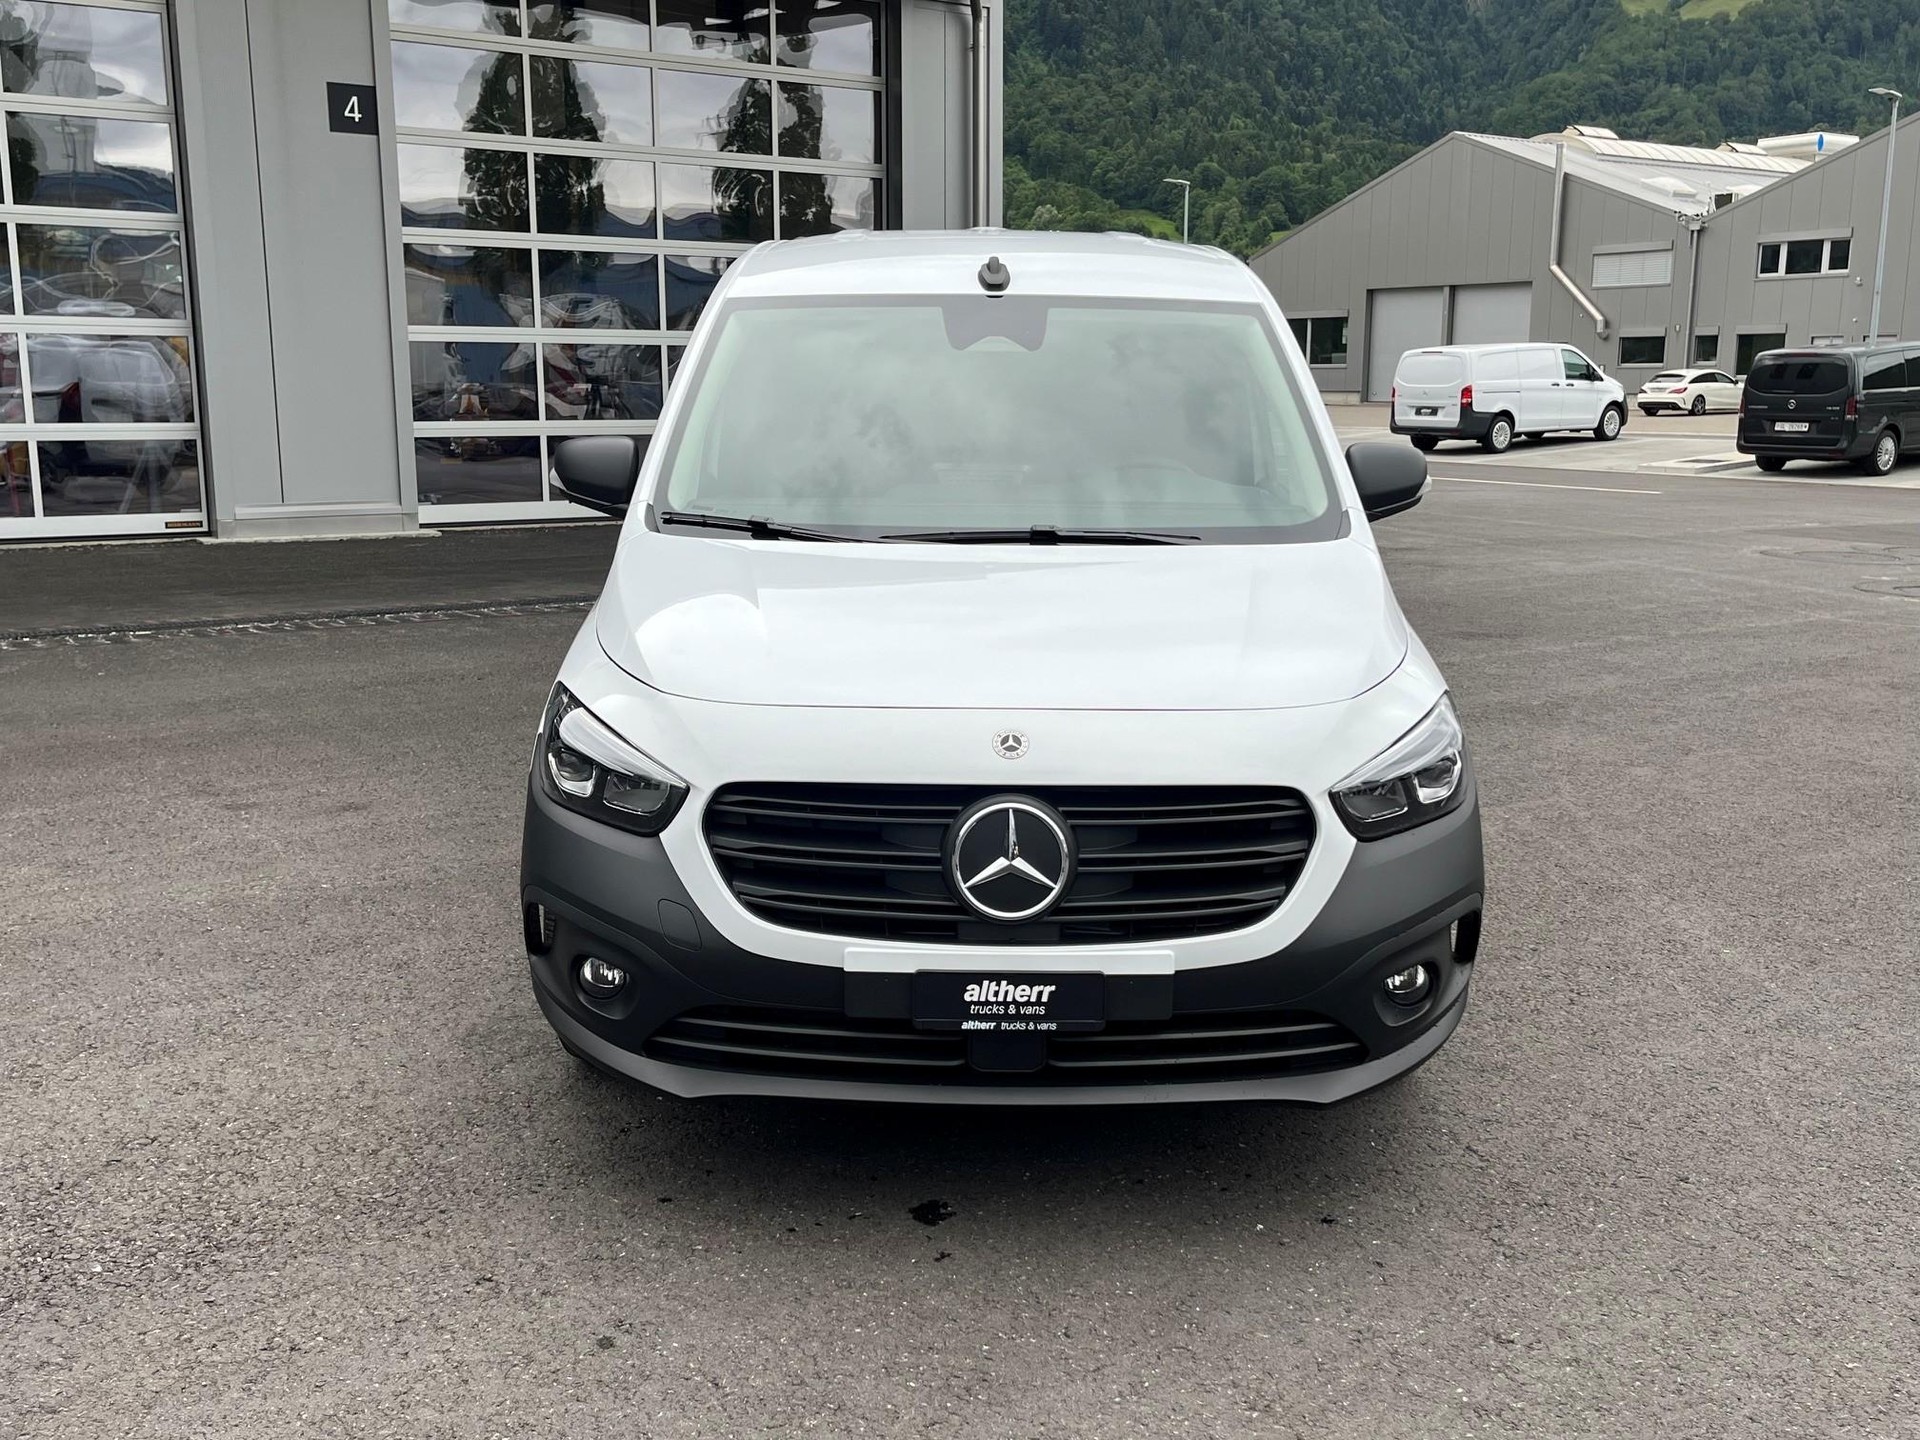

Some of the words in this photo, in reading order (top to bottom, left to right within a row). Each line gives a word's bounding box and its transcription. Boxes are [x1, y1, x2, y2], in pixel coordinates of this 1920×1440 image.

[344, 96, 362, 122] 4
[963, 980, 1056, 1002] altherr
[970, 1004, 1005, 1014] trucks
[1007, 1004, 1016, 1014] &
[1020, 1006, 1046, 1015] vans
[961, 1020, 997, 1030] altherr
[1001, 1021, 1027, 1030] trucks
[1027, 1021, 1035, 1030] &
